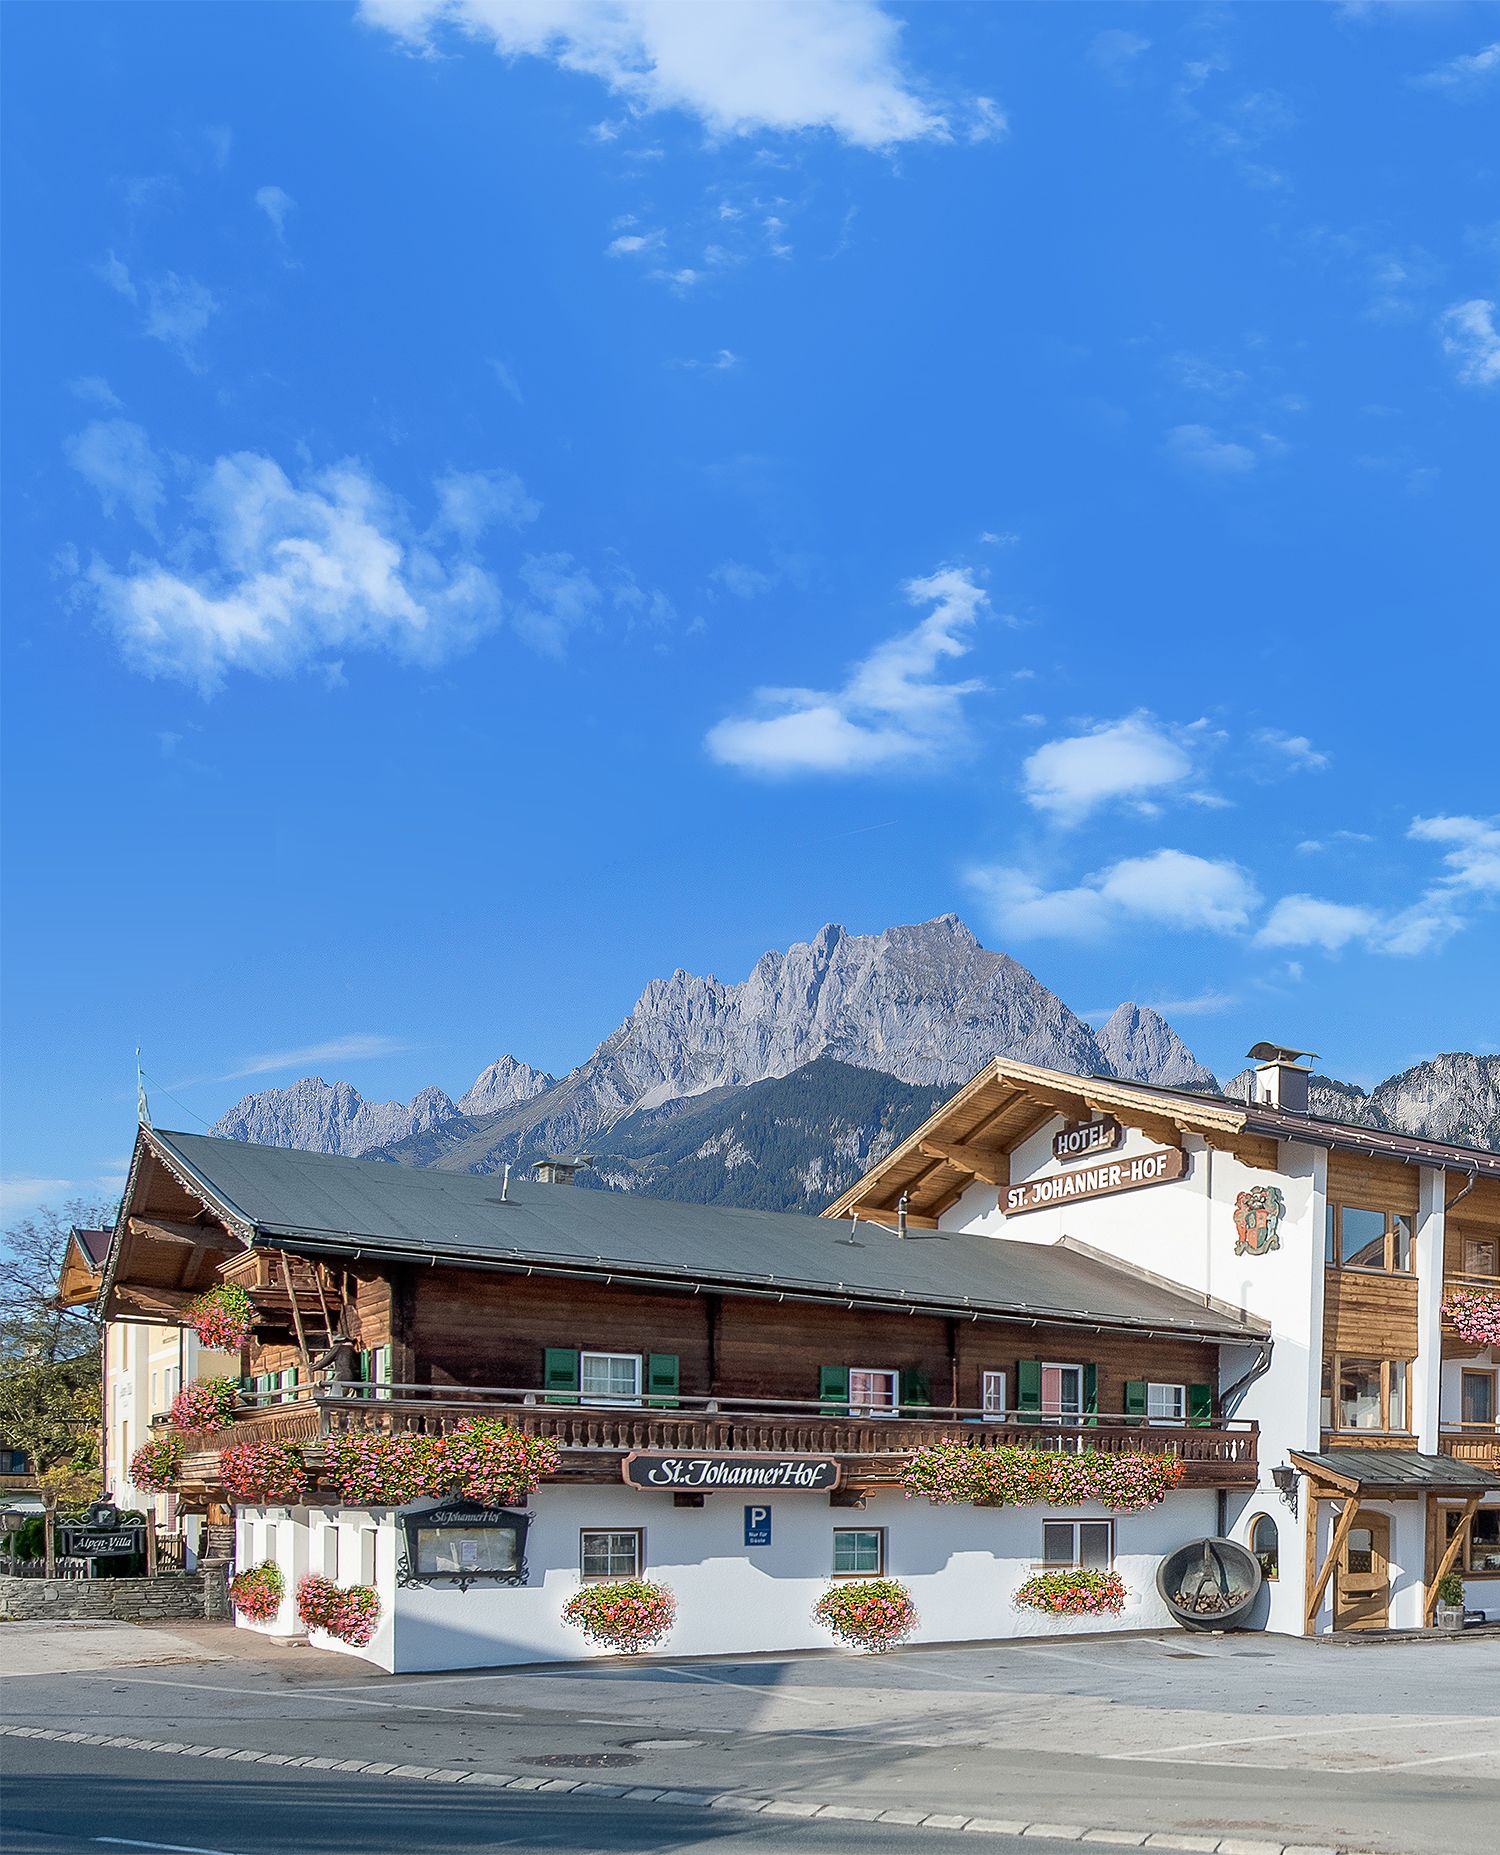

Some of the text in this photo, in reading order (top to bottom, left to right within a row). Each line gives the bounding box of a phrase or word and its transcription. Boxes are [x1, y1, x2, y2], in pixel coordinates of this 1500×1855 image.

[1057, 1125, 1109, 1155] HOTEL
[1007, 1155, 1168, 1209] ST. JOHANNER-HOF
[751, 1507, 767, 1528] P
[74, 1537, 132, 1549] Alpen-Villa
